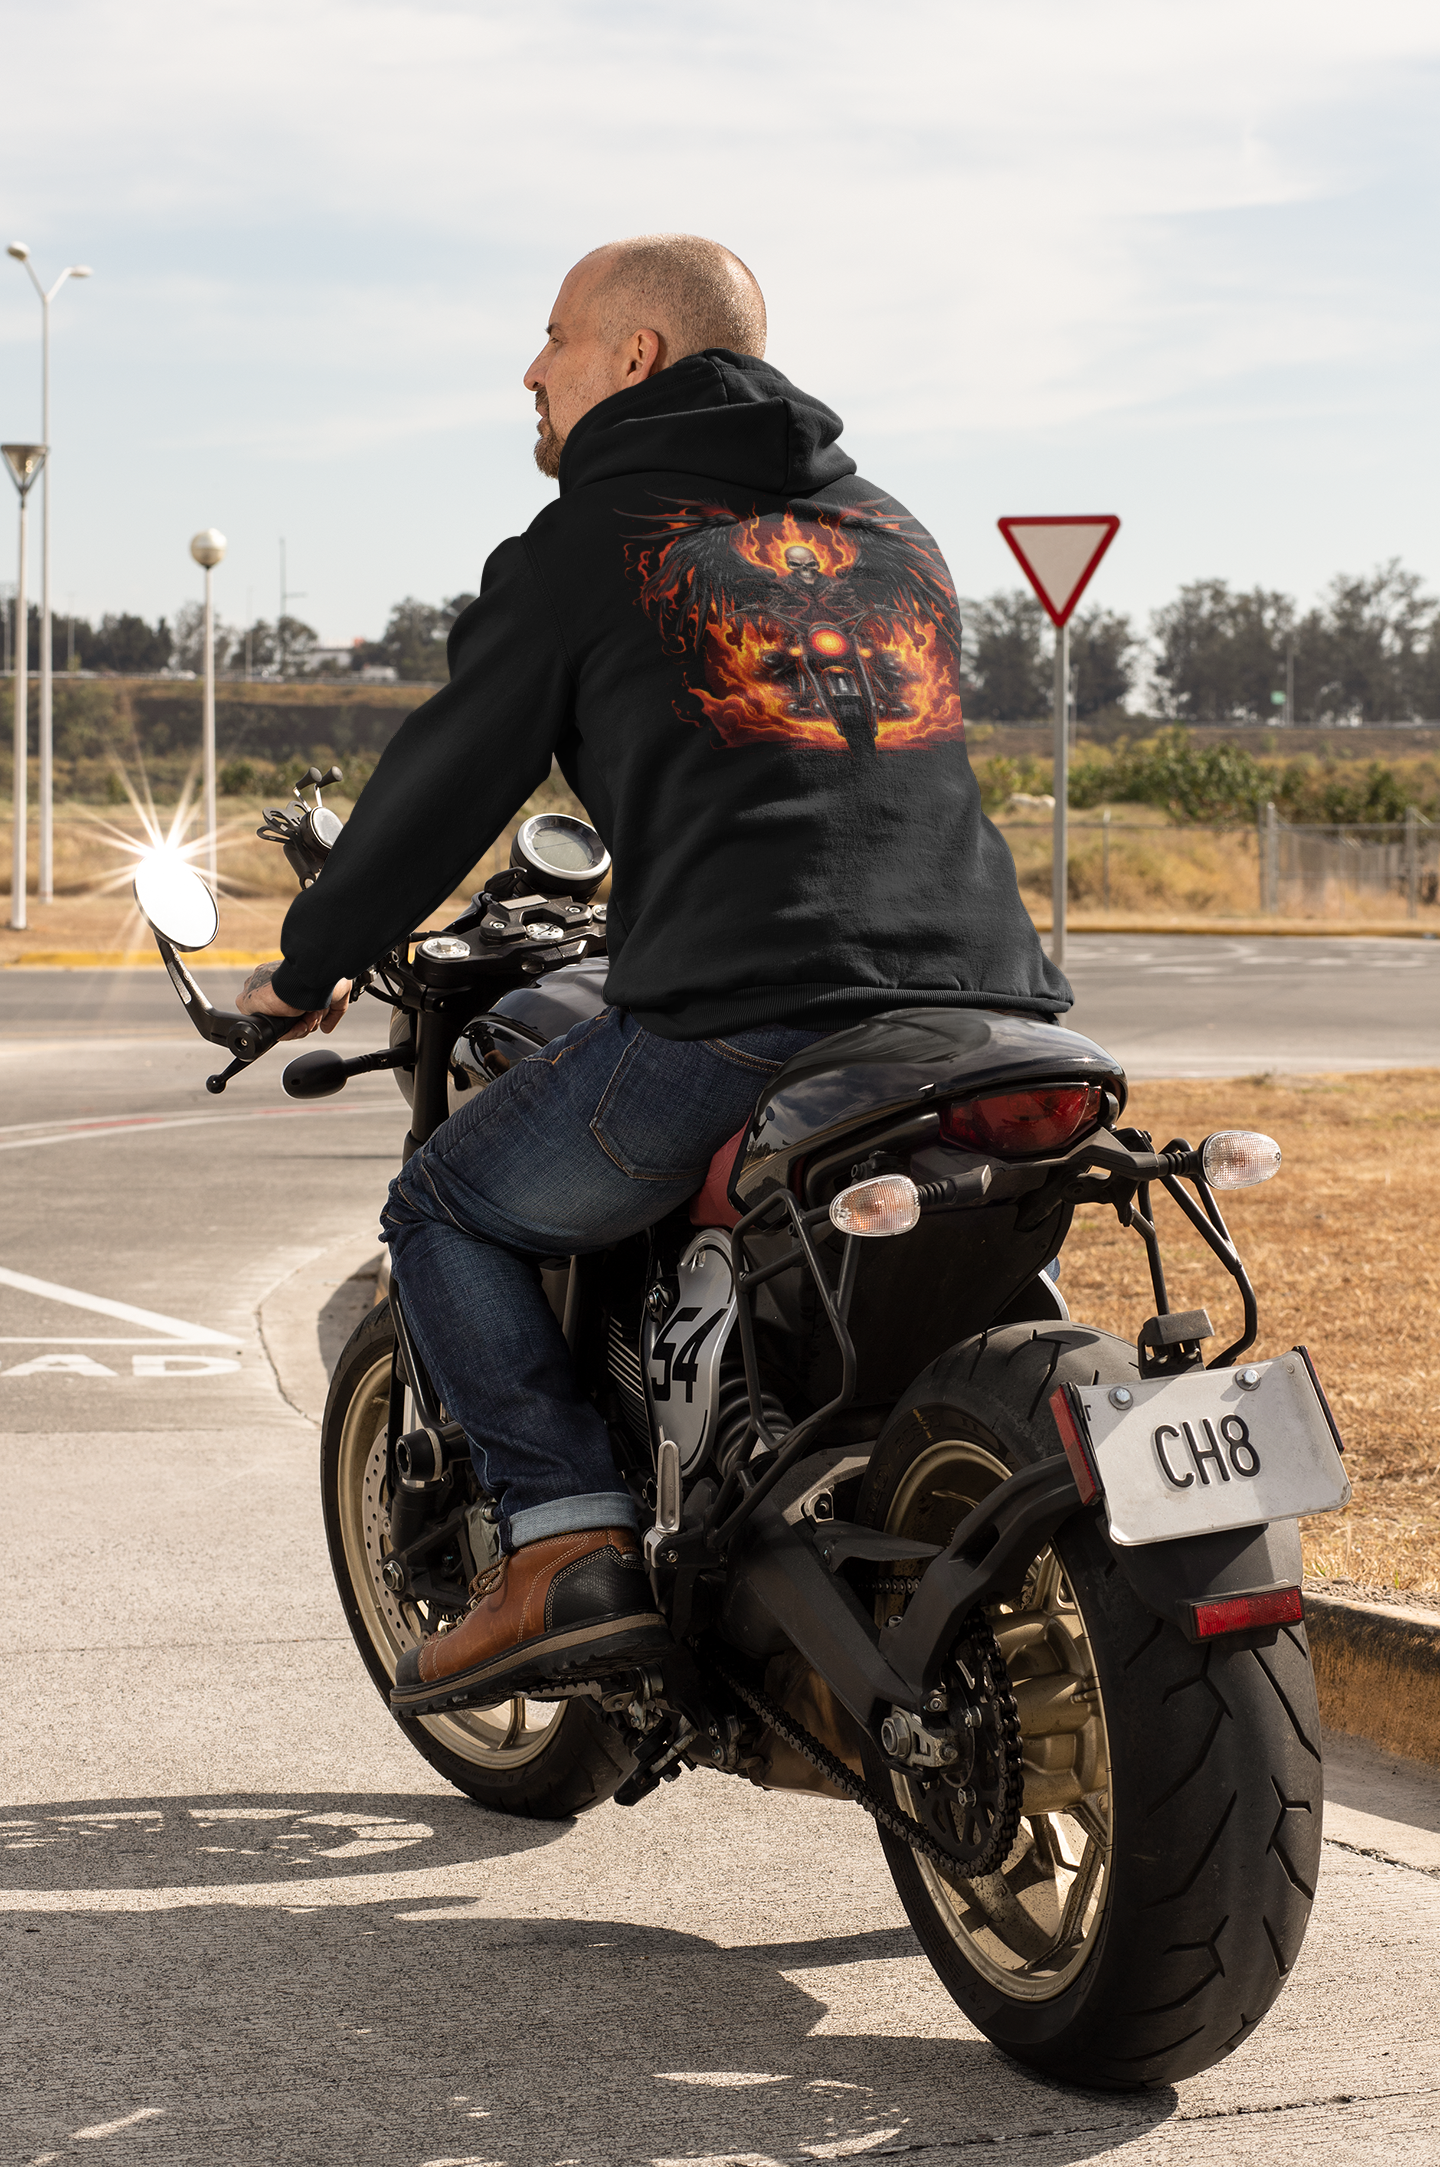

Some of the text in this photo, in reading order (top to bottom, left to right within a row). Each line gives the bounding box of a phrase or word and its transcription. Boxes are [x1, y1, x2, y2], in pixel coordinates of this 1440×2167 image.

[0, 1354, 242, 1377] AD
[651, 1307, 729, 1403] 54
[1154, 1414, 1261, 1488] CH8
